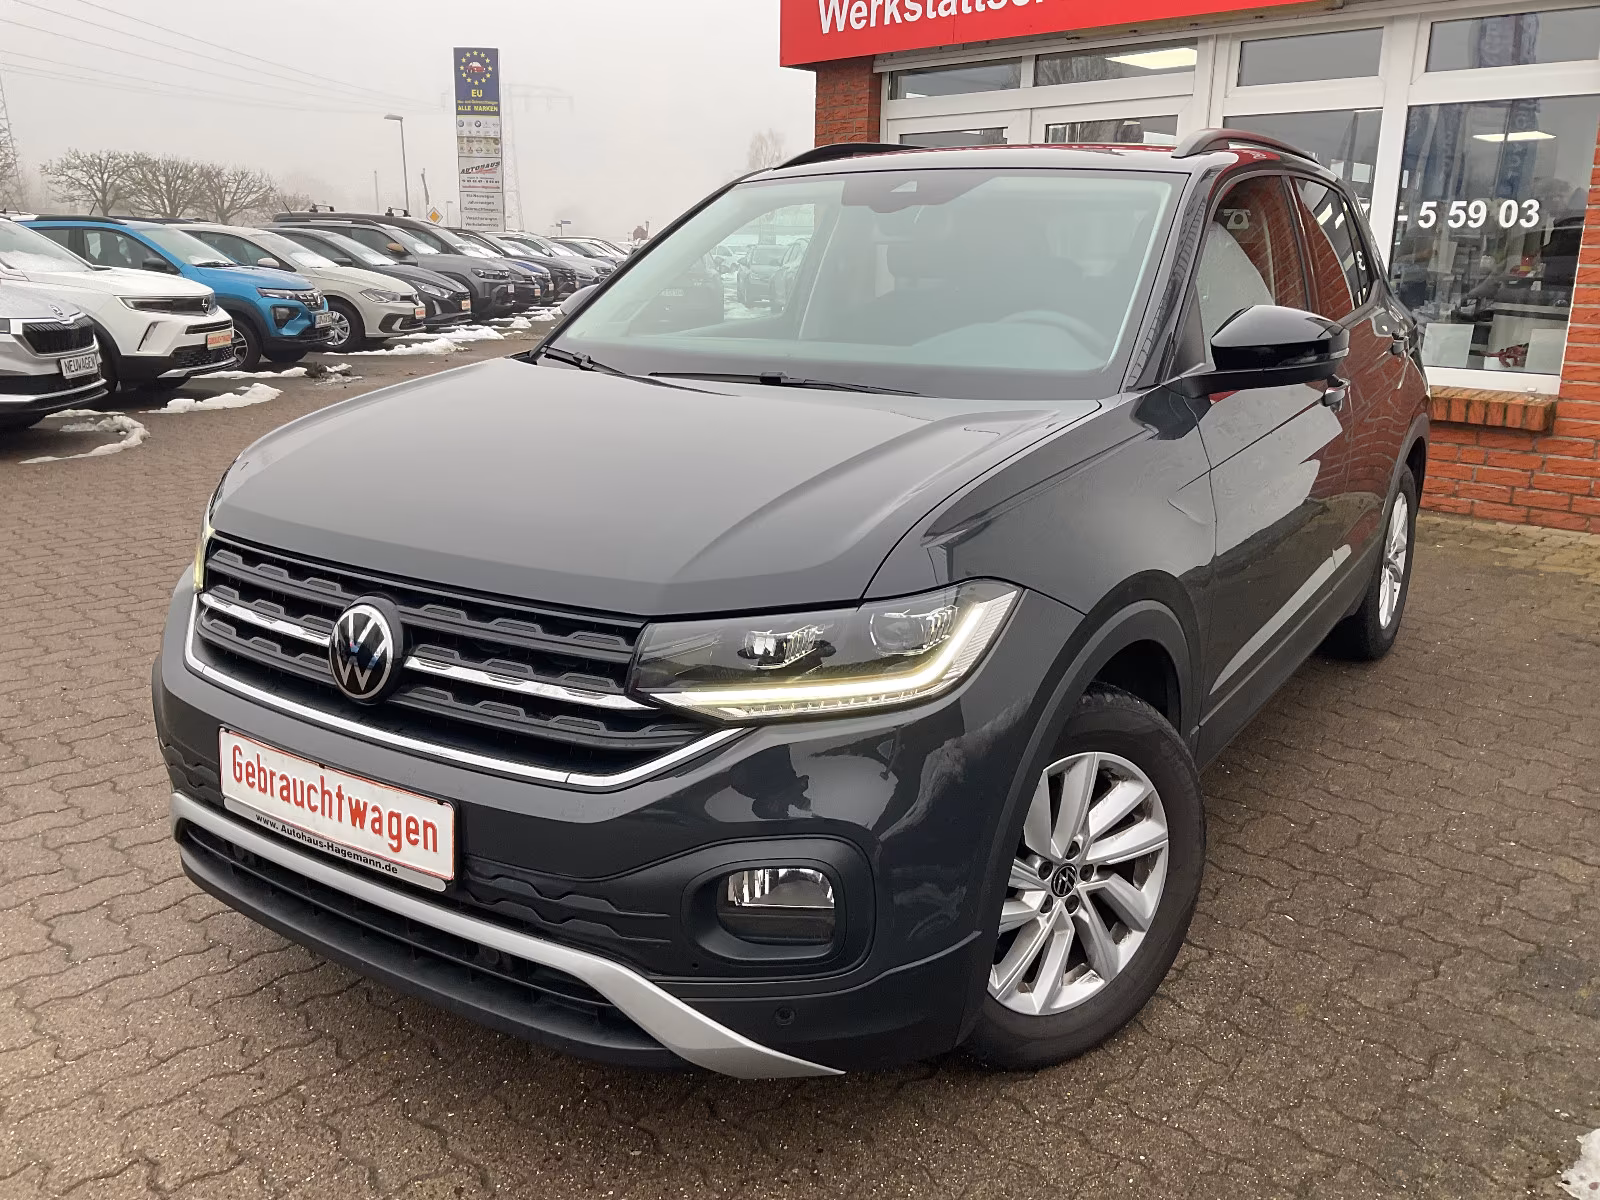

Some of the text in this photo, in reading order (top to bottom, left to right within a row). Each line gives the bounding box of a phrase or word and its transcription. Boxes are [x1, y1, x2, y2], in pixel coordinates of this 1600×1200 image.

[471, 89, 483, 98] EU
[1417, 200, 1438, 229] 5
[1447, 199, 1488, 229] 59
[1498, 198, 1541, 229] 03
[63, 356, 96, 374] NEUWAGEN
[231, 743, 438, 853] Gebrauchtwagen
